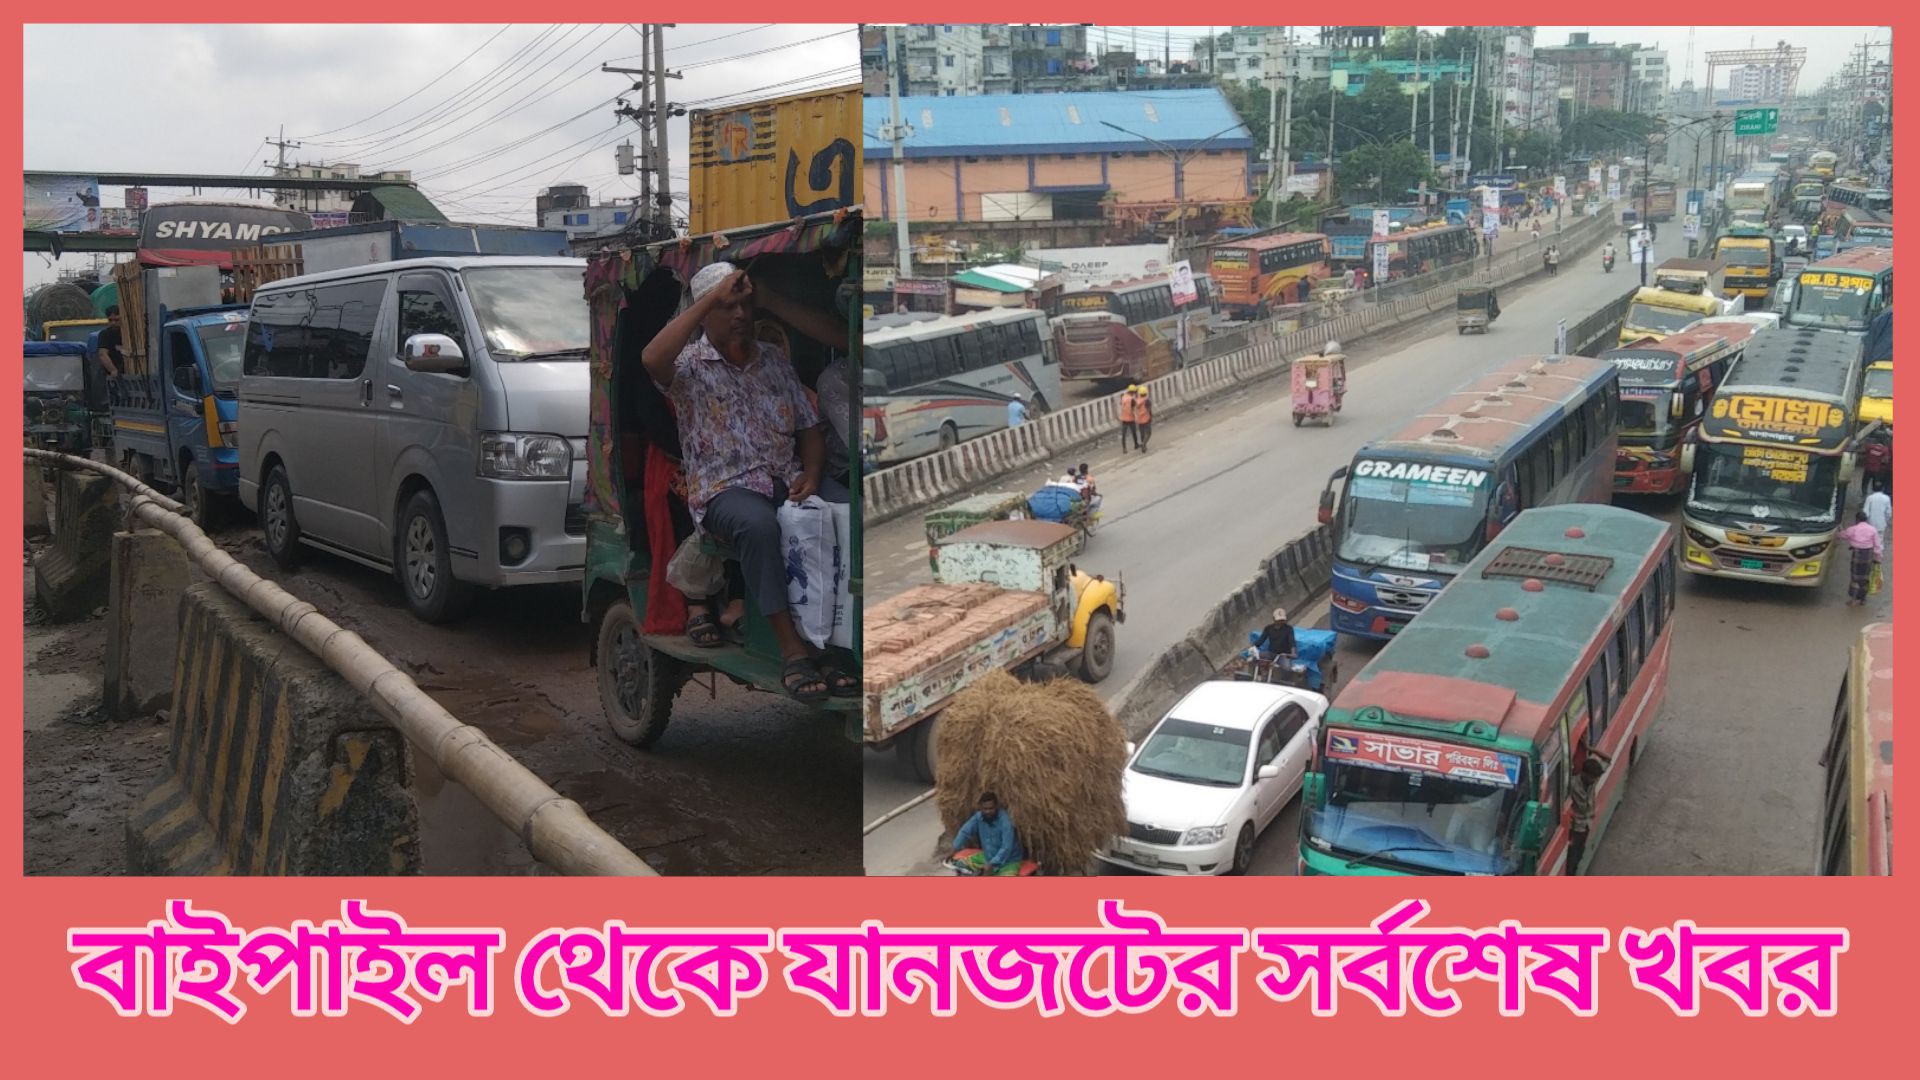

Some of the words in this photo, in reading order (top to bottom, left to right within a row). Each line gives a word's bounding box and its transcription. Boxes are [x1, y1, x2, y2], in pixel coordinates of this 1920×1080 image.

[155, 220, 290, 242] SHYAMO
[1728, 395, 1832, 429] মোল্লা
[1355, 459, 1488, 487] GRAMEEN
[1363, 740, 1443, 769] সাভার
